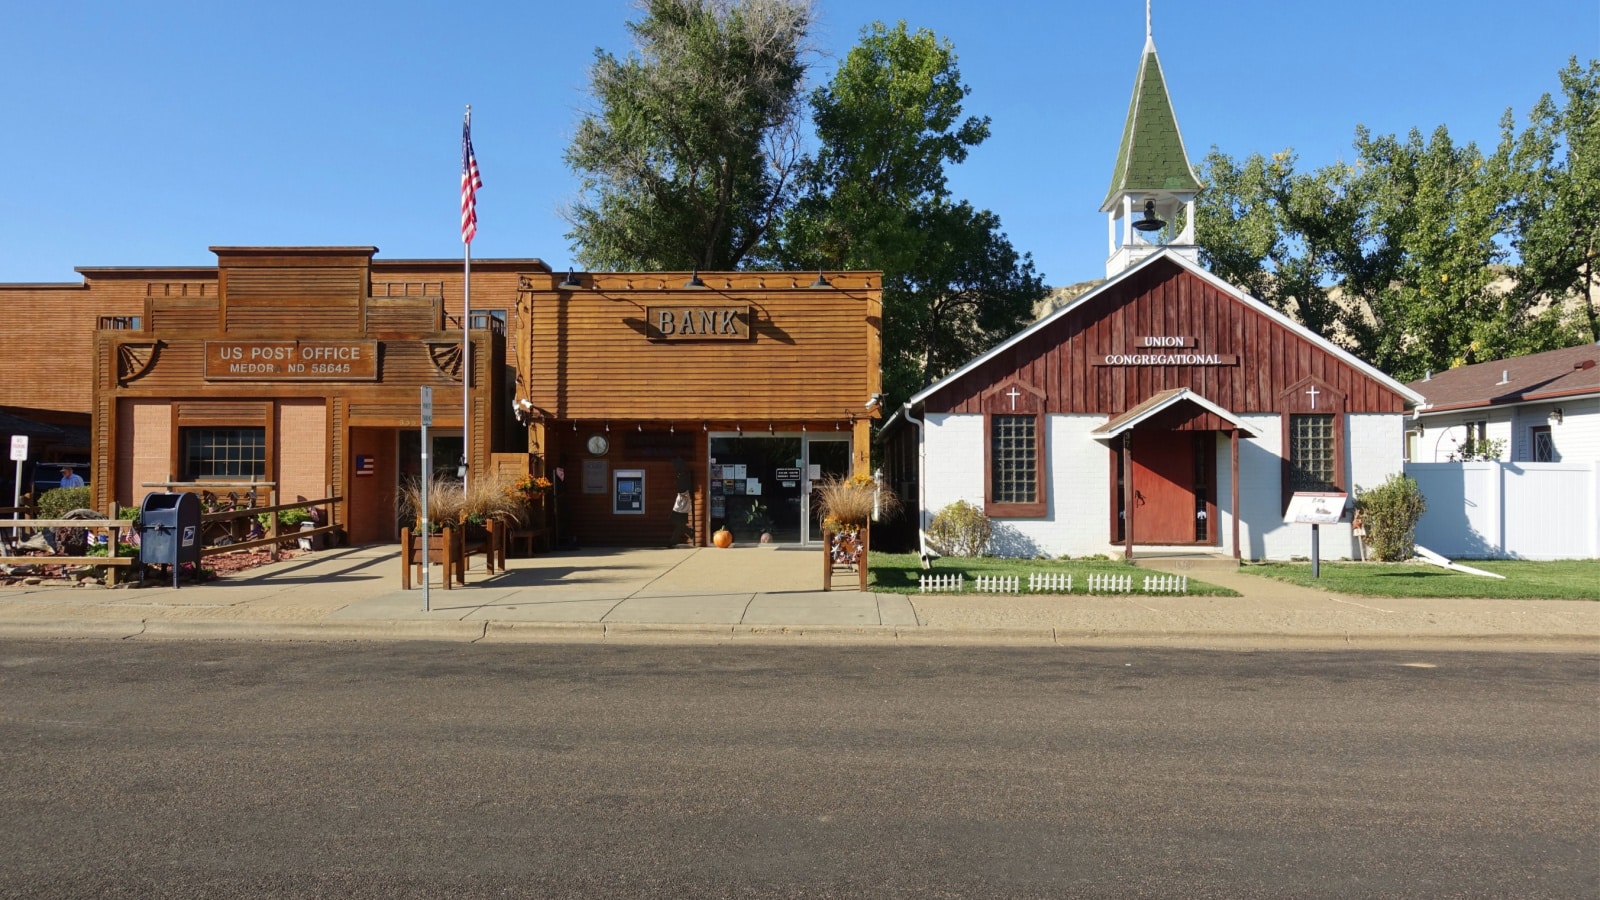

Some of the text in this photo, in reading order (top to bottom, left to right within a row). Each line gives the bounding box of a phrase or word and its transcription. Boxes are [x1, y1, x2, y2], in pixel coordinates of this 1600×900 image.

[659, 310, 738, 334] BANK
[1144, 336, 1184, 347] UNION
[220, 347, 361, 360] US POST OFFICE
[1105, 354, 1221, 365] CONGREGATIONAL
[288, 363, 305, 374] ND
[311, 363, 351, 374] 58645
